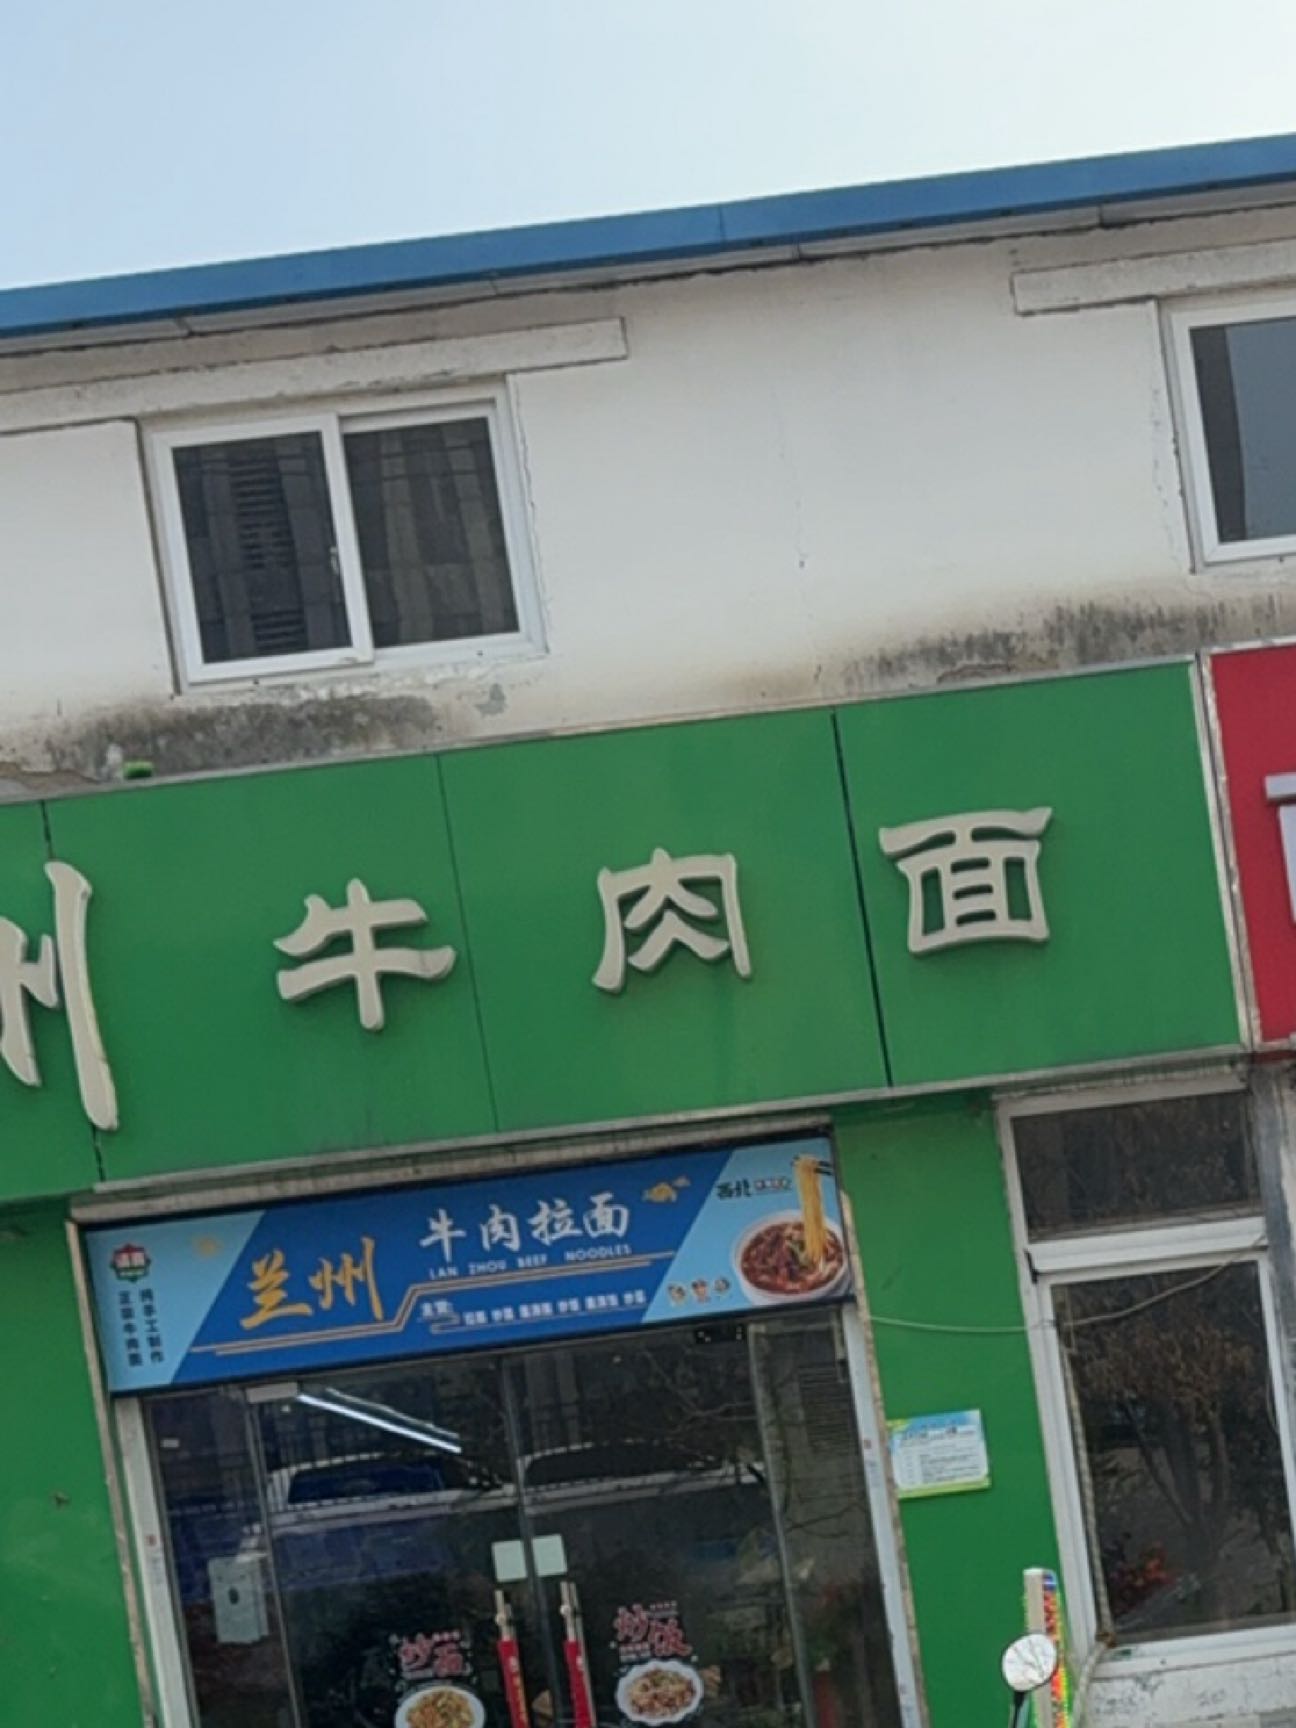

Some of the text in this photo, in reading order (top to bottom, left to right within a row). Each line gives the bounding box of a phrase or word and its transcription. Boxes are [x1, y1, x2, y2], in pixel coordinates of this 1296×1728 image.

[420, 1192, 630, 1264] 牛肉拉面
[565, 1244, 632, 1261] NOODLES
[240, 1234, 384, 1331] 兰州
